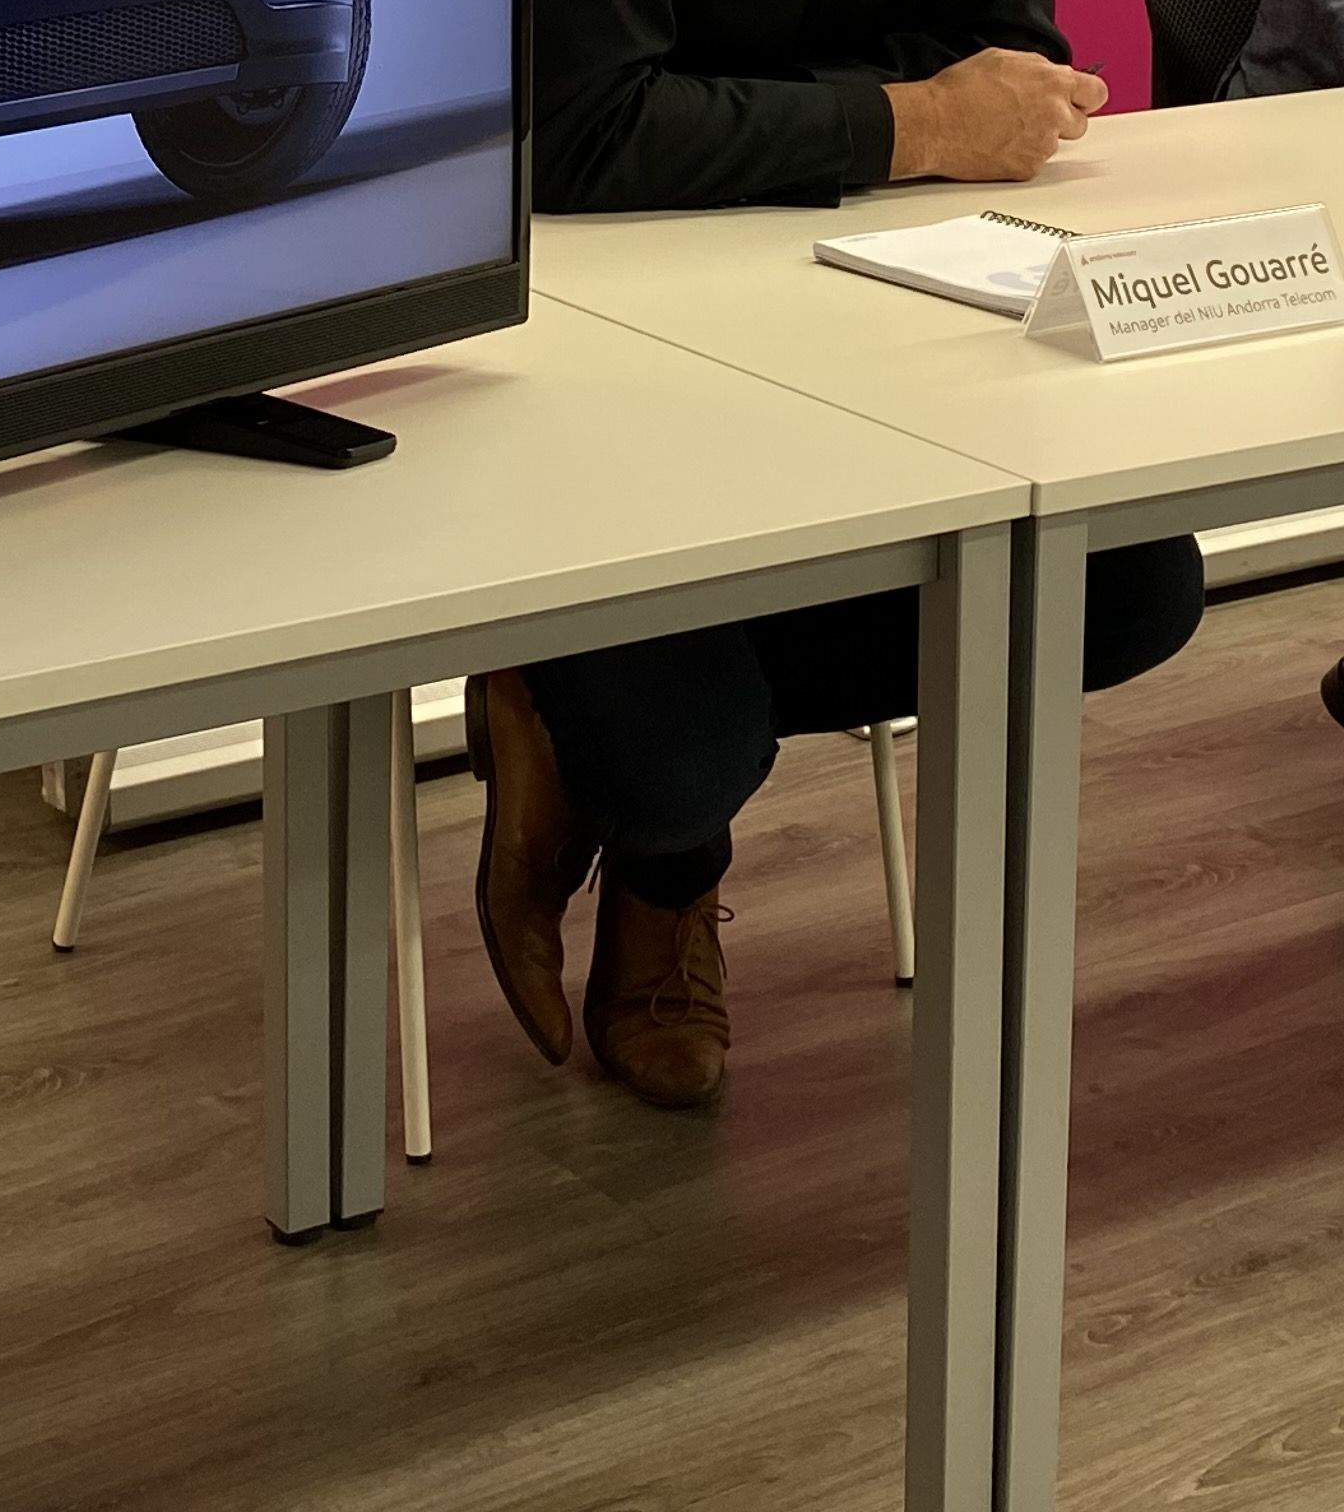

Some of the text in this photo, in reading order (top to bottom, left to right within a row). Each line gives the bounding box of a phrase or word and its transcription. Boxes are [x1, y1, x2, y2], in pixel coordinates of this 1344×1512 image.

[1091, 242, 1329, 309] Miquel Gouarré
[1109, 289, 1337, 336] Manager del NIU Andorra Telecom
